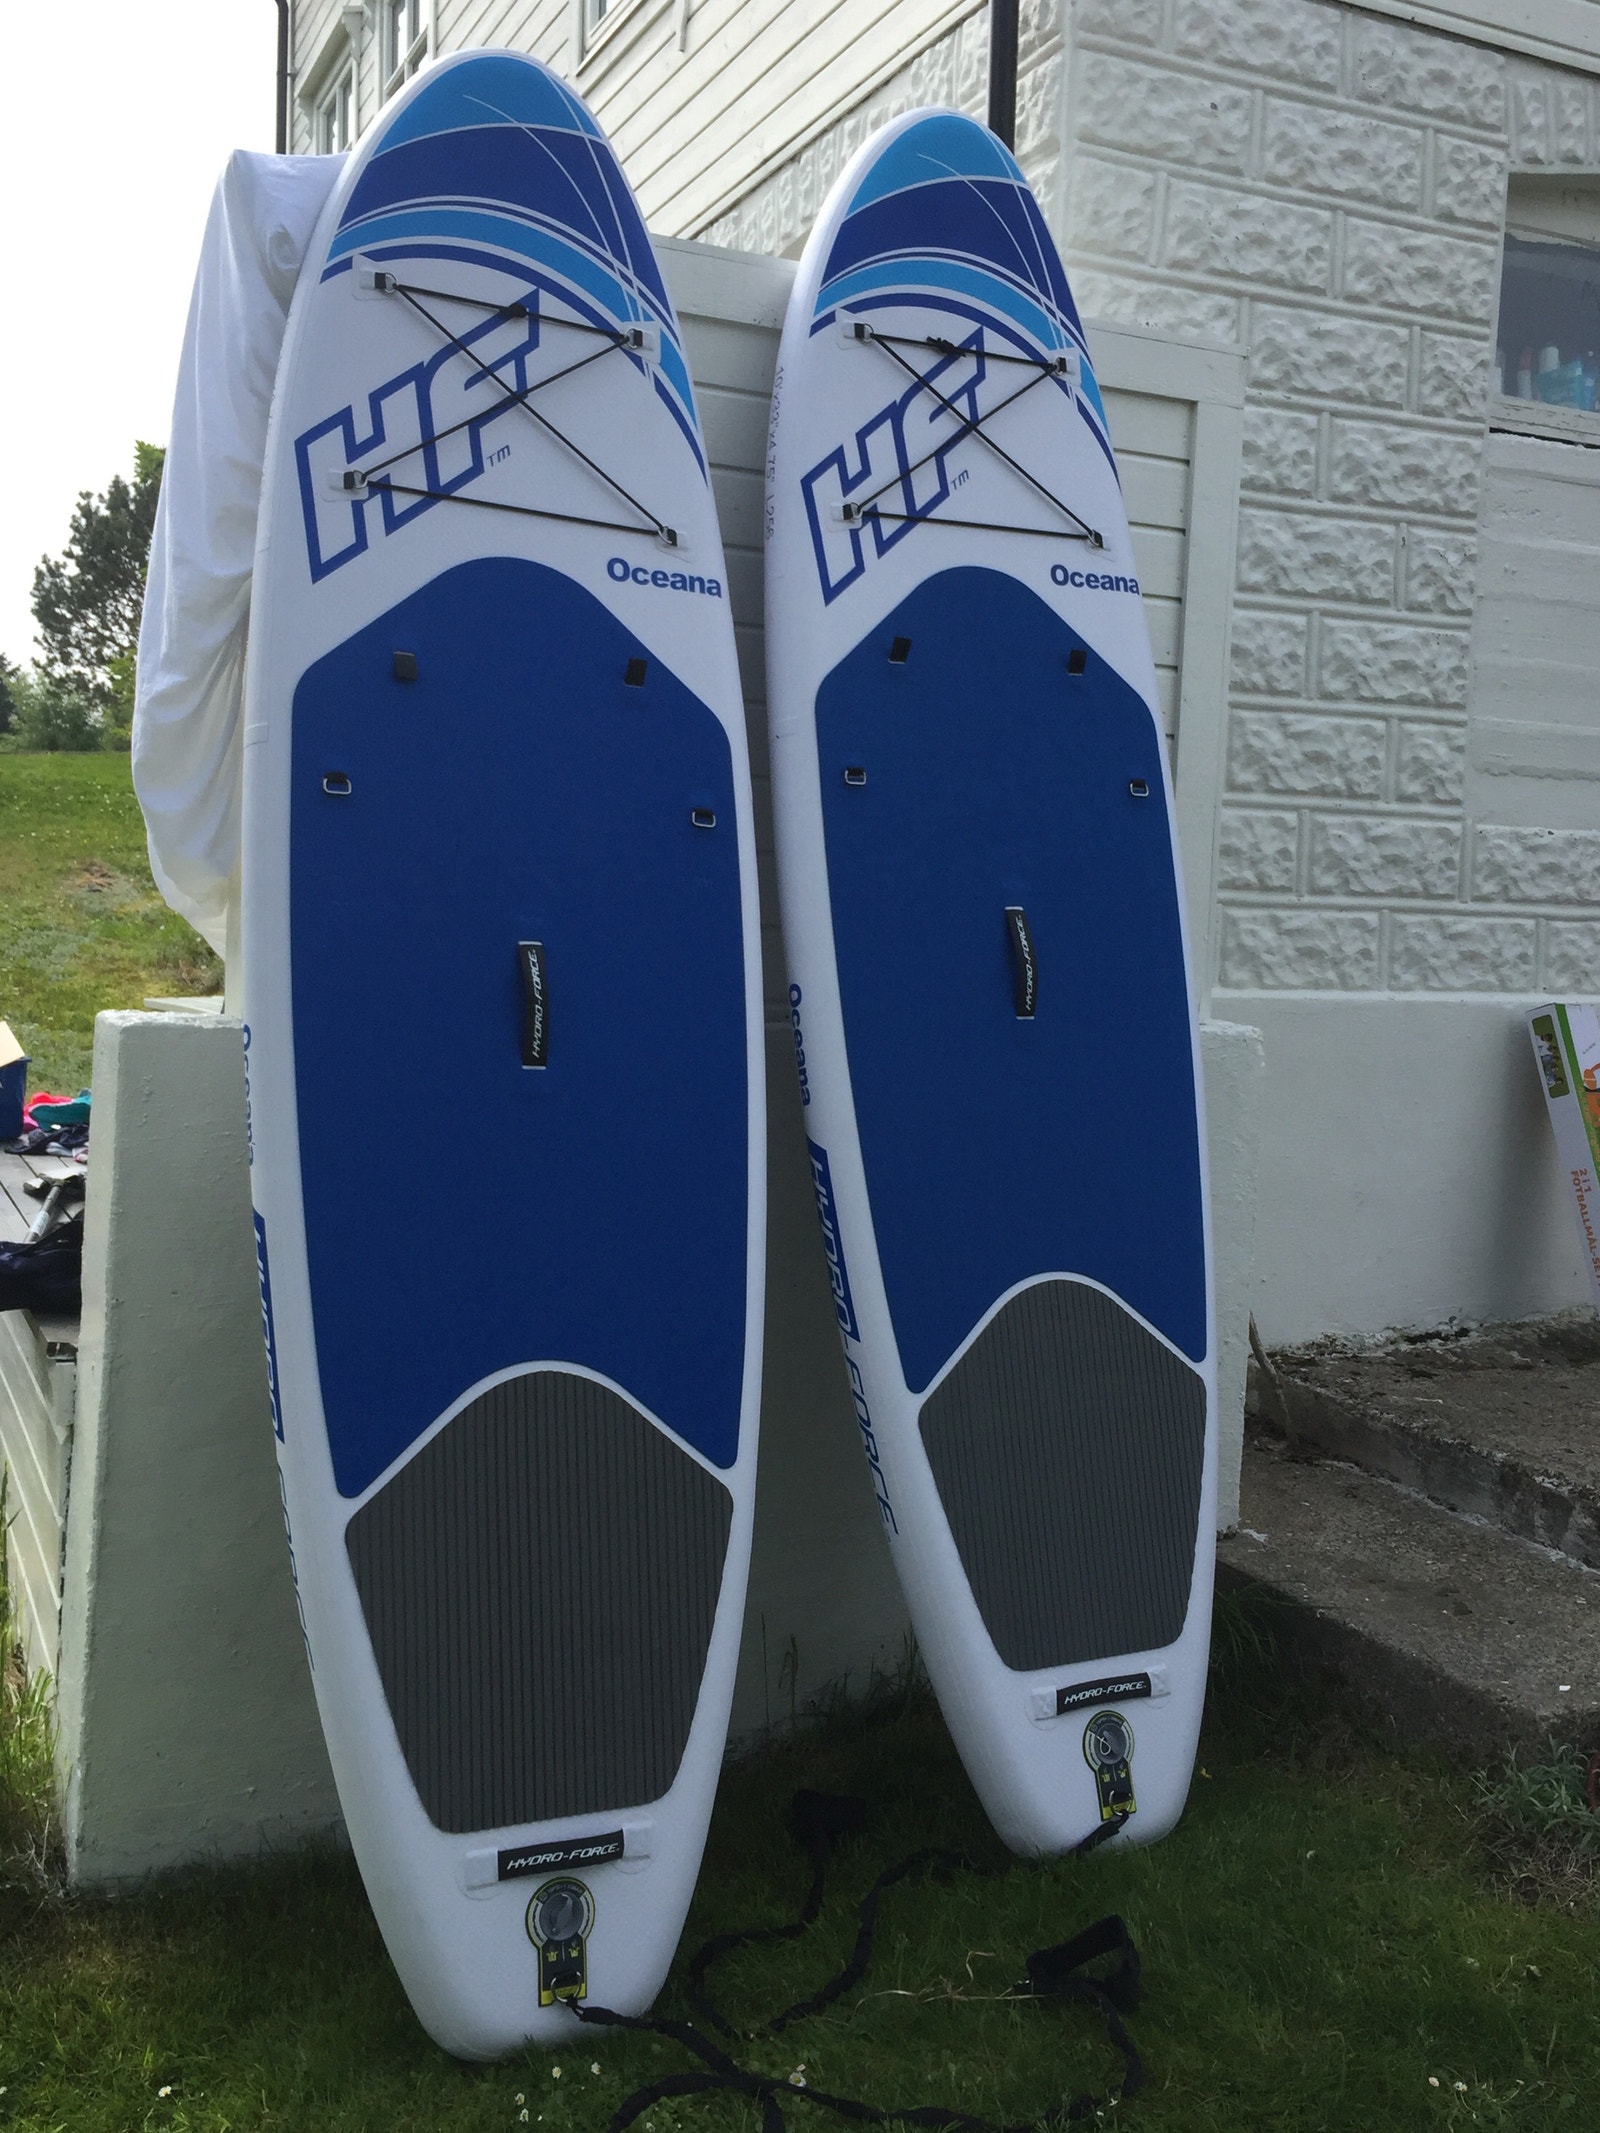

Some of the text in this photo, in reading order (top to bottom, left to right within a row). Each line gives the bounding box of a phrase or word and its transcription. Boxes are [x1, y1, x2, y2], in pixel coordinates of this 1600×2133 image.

[294, 288, 540, 584] HF
[800, 326, 987, 608] HF
[606, 557, 722, 599] Oceana
[1050, 564, 1140, 596] Oceana
[527, 950, 543, 1058] HYDRO-FORCE
[1015, 916, 1033, 1011] HYDRO-FORCE
[788, 982, 811, 1108] Oceana
[1064, 1681, 1145, 1705] HYDRO-FORCE
[507, 1842, 619, 1870] HYDRO-FORCE
